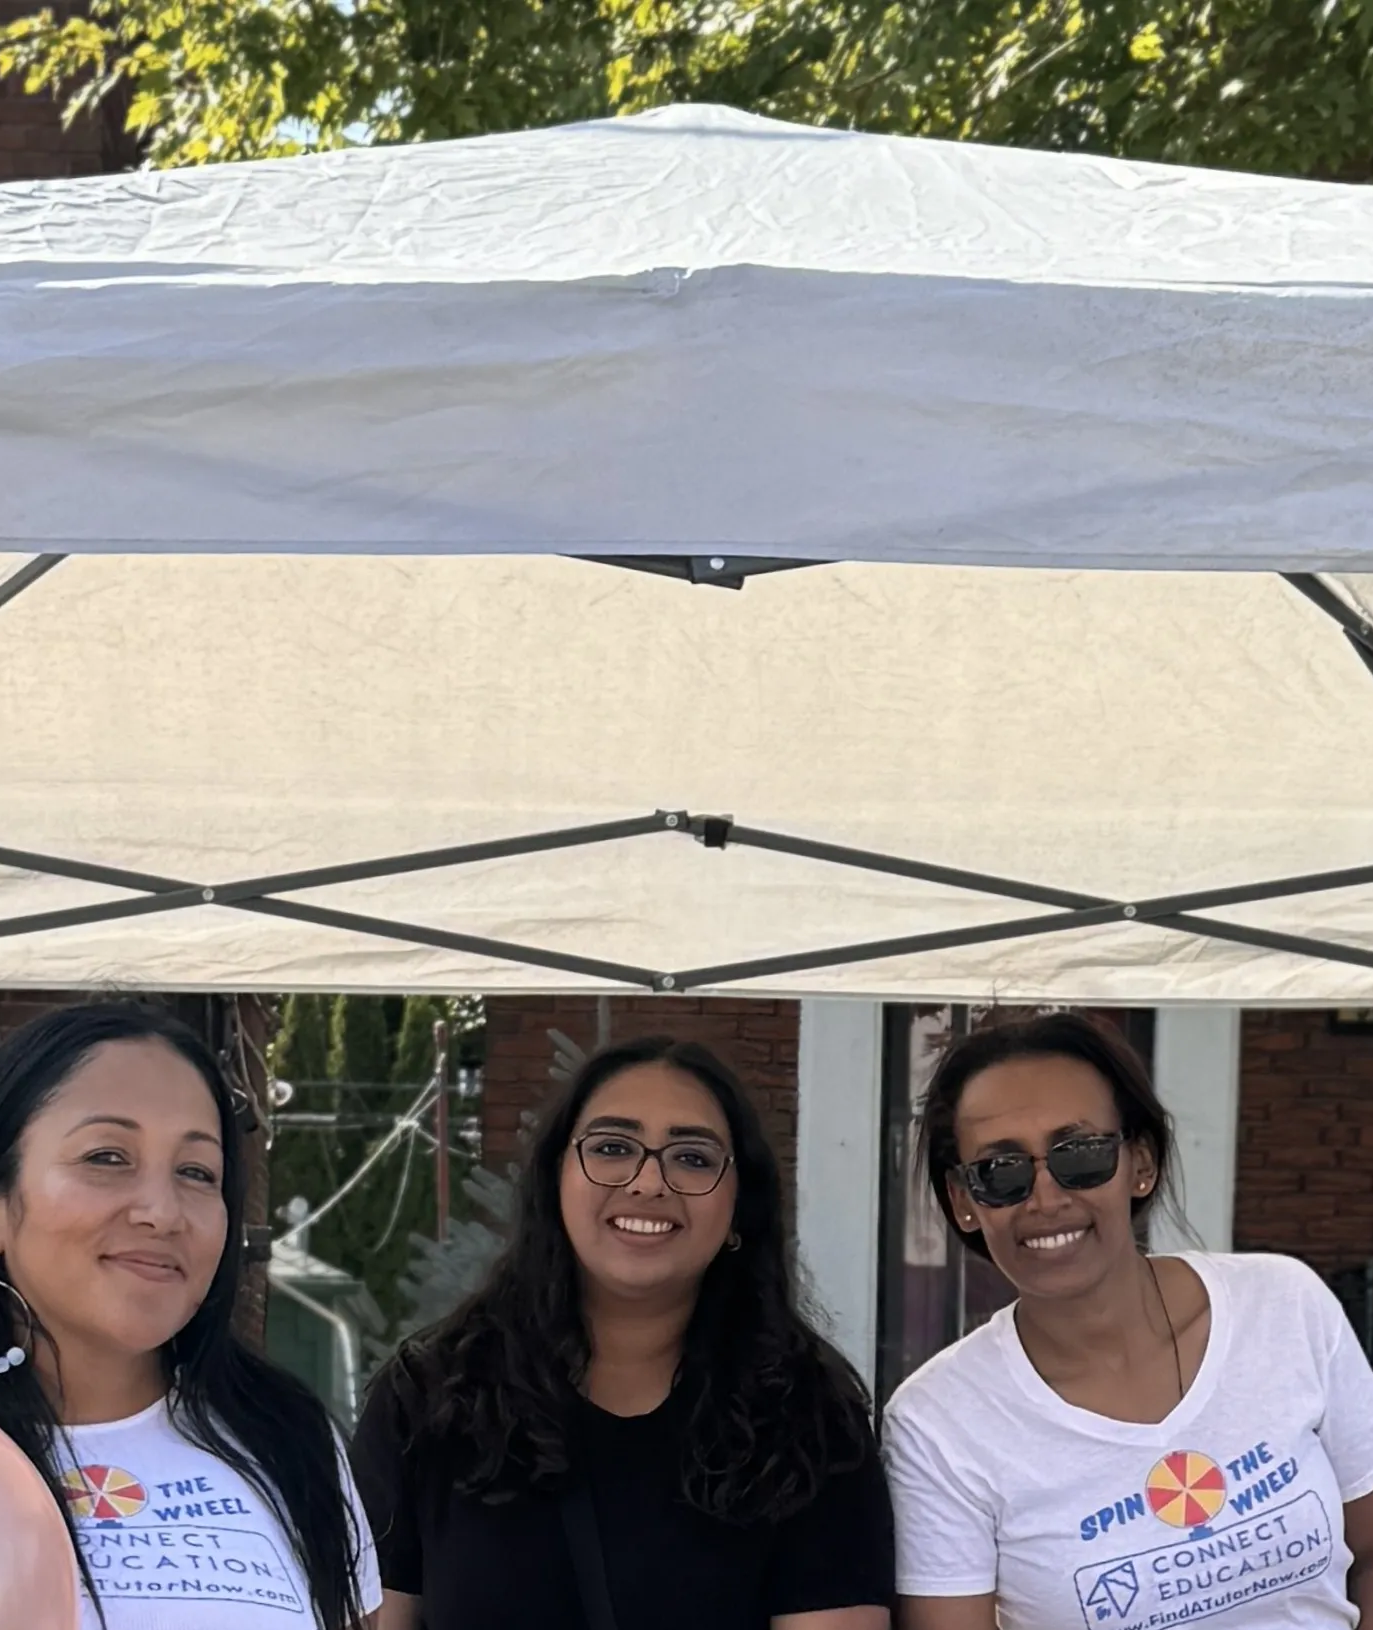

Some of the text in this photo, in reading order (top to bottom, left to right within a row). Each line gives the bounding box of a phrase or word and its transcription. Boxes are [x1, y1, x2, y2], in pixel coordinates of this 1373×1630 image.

[1226, 1441, 1273, 1481] THE
[155, 1476, 215, 1499] THE
[152, 1497, 252, 1522] WHEEL
[1080, 1493, 1145, 1541] SPIN
[78, 1532, 222, 1549] ONNECT
[1152, 1515, 1287, 1574] CONNECT
[88, 1554, 274, 1579] UCATION
[81, 1579, 298, 1604] TutorNow.com
